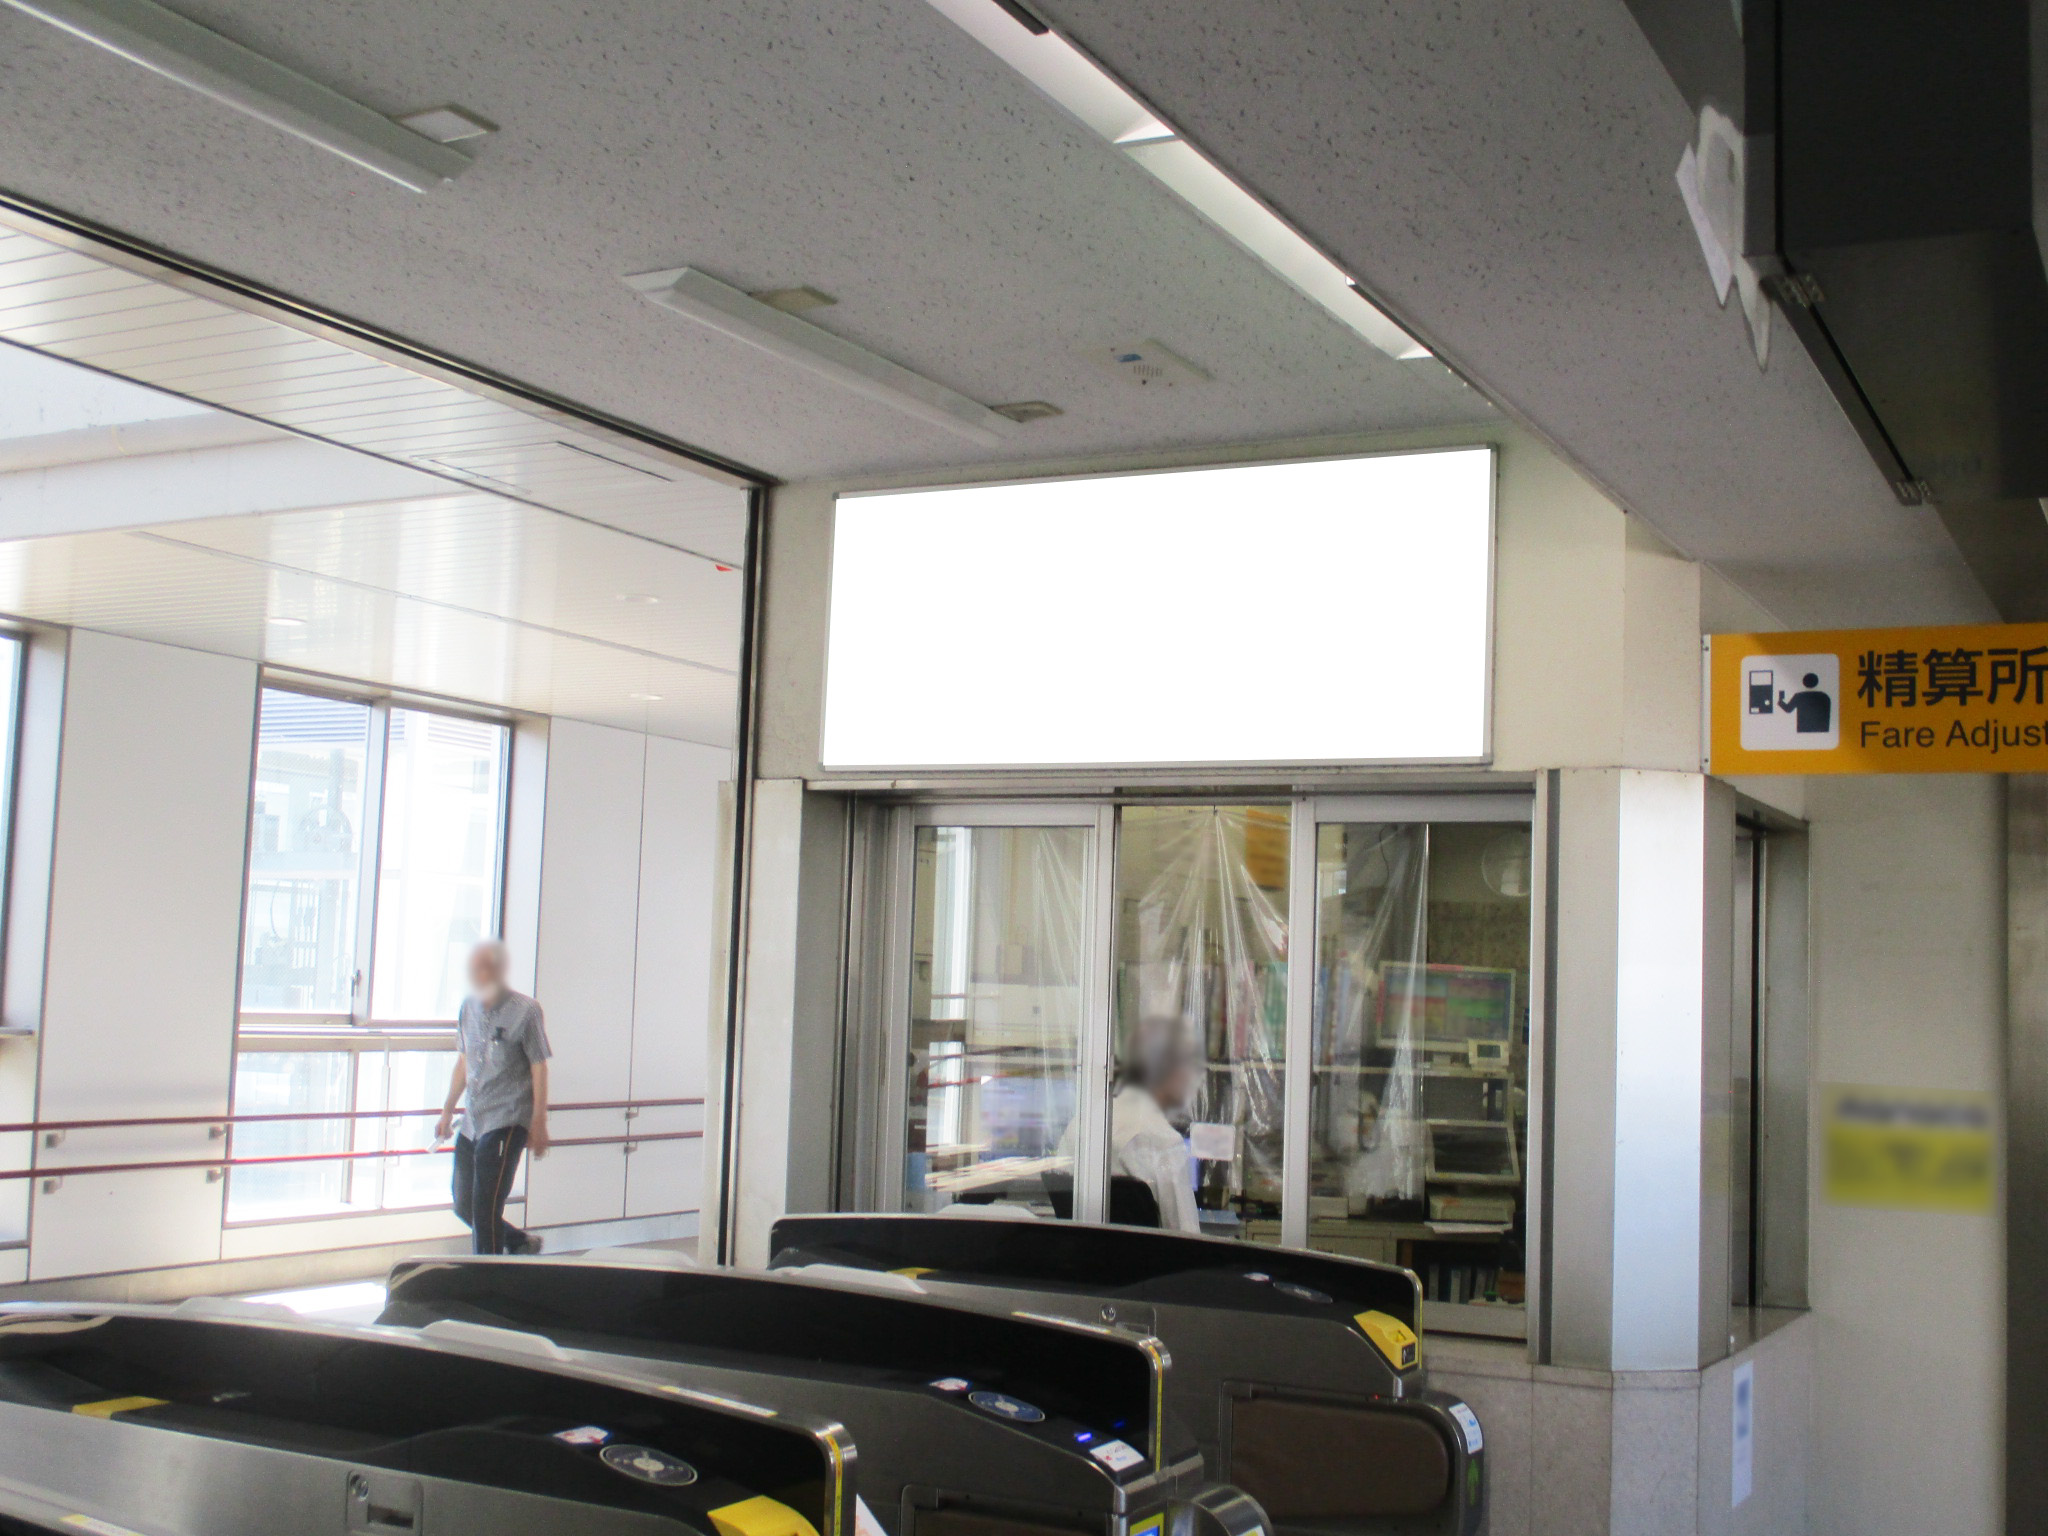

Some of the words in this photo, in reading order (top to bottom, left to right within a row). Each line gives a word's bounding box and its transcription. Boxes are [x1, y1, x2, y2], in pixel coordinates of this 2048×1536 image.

[1857, 646, 2048, 708] 精算所
[1860, 720, 1935, 749] Fare
